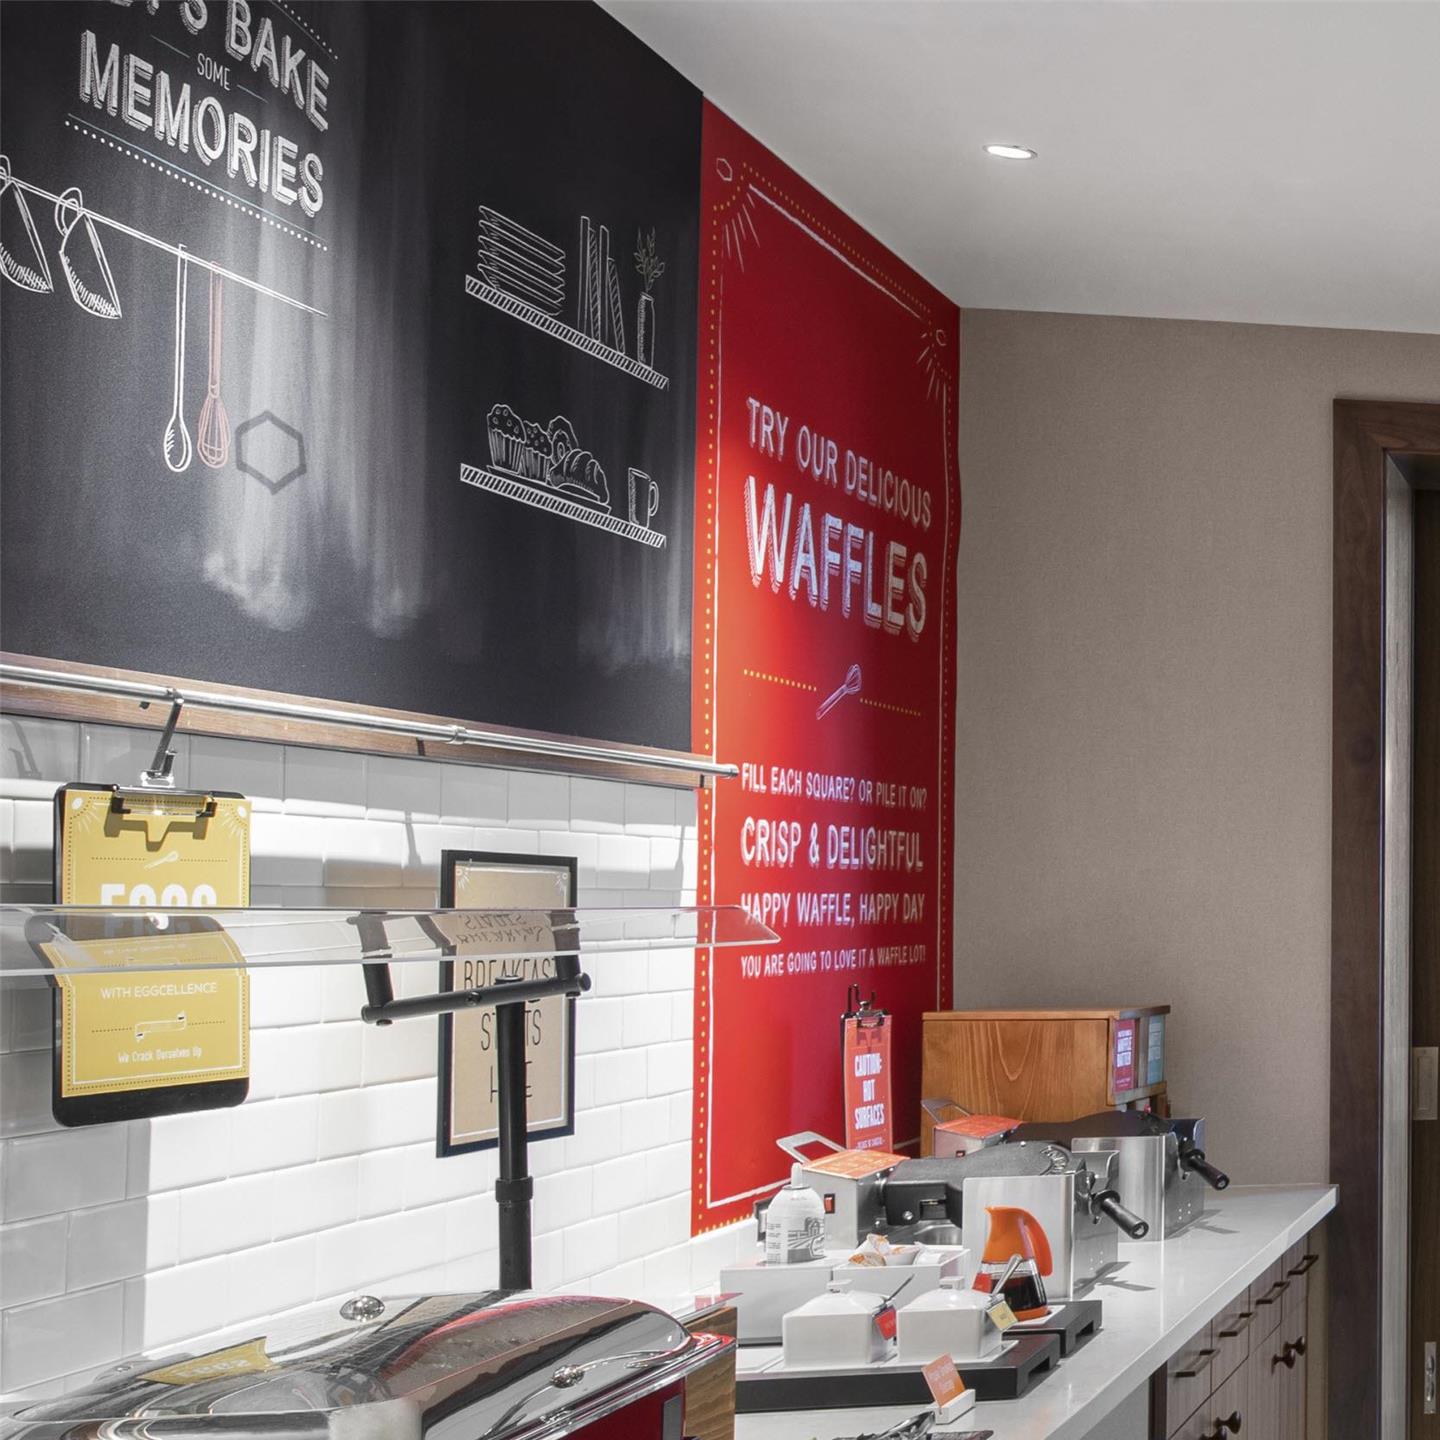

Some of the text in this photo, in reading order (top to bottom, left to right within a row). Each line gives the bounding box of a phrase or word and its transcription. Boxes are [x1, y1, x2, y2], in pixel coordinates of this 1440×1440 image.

[196, 52, 231, 92] SOME
[225, 0, 330, 131] BAKE
[79, 29, 324, 218] MEMORIES
[746, 396, 932, 532] TRY OUR DELICIOUS
[743, 474, 929, 643] WAFFLES
[742, 762, 928, 811] FILL EACH SQUARE? OR PILE IT ON?
[740, 816, 924, 873] CRISP & DELIGHTFUL
[741, 892, 926, 928] HAPPY WAFFLE, HAPPY DAY
[741, 945, 926, 980] YOU ARE GOING TO LOVE IT A WAFFLE LOT!
[101, 982, 218, 999] WITH EGGCELLENCE
